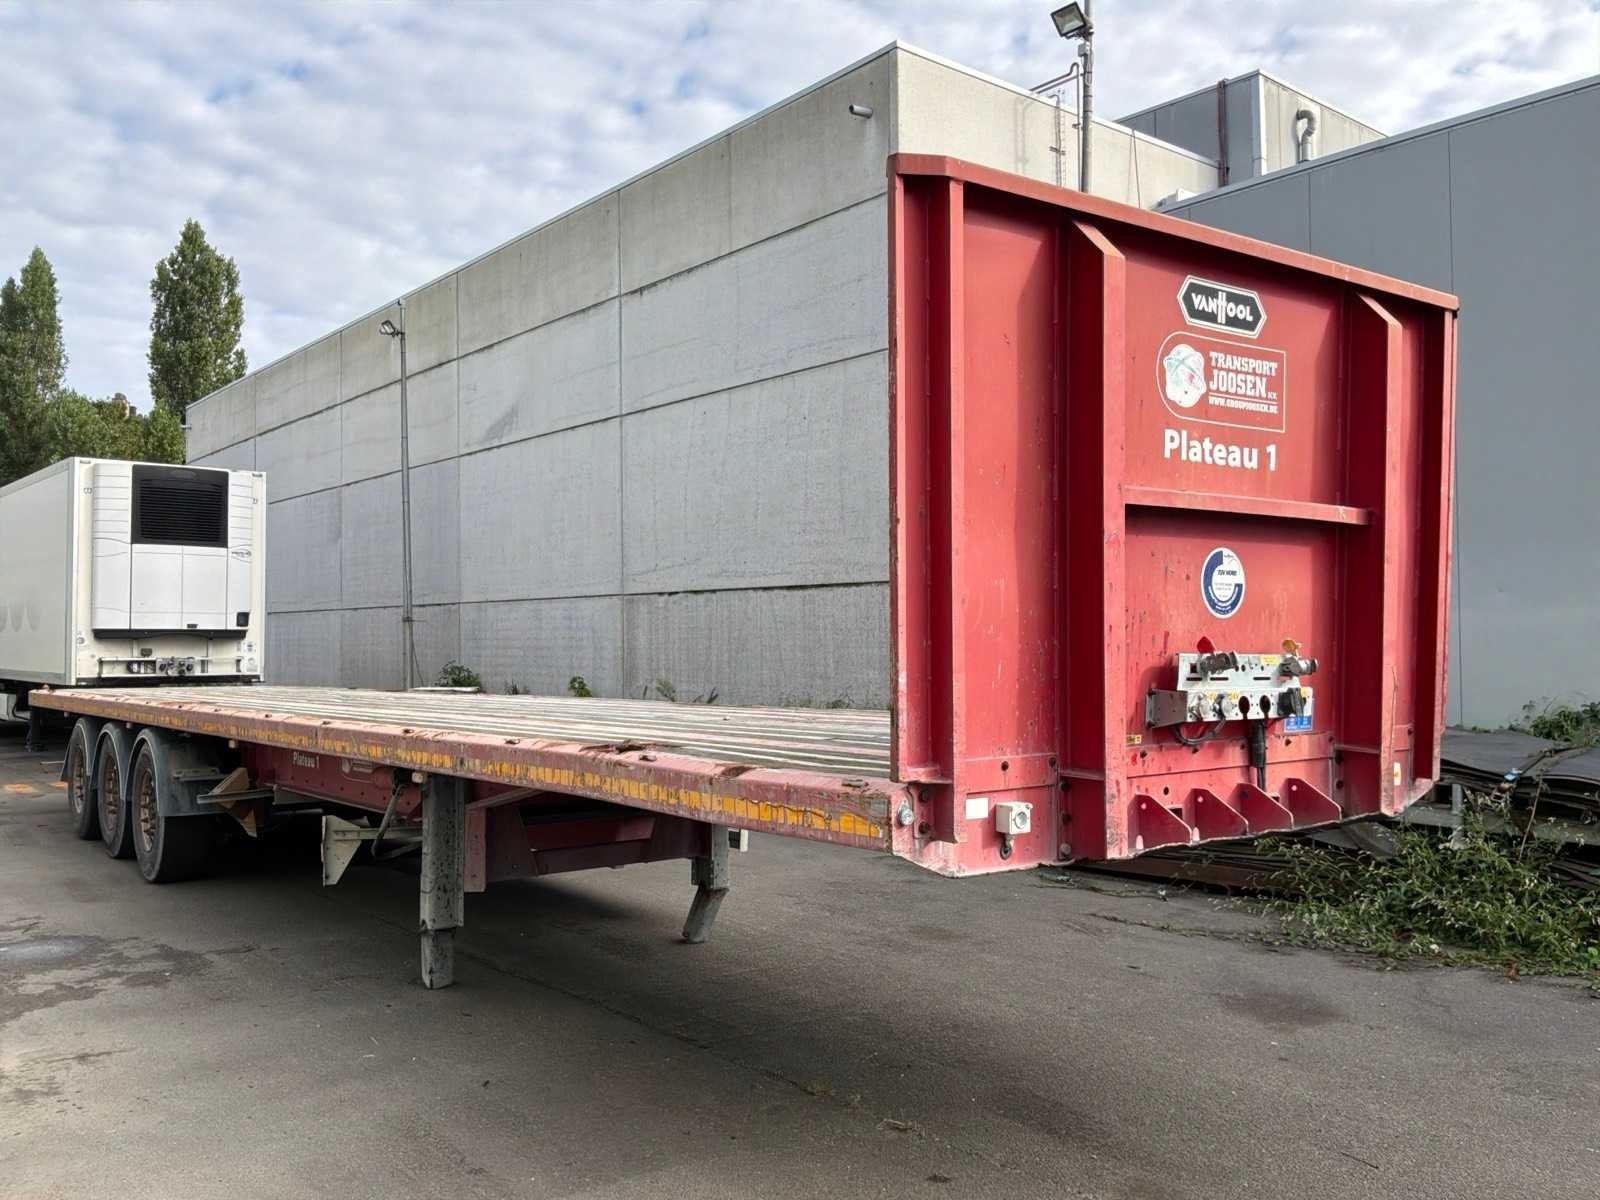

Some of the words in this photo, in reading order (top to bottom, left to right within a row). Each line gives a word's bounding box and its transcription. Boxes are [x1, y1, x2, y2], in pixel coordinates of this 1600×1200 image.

[1209, 351, 1278, 376] TRANSPORT
[1209, 369, 1267, 398] JOOSEN
[1163, 429, 1258, 469] Plateau
[1266, 444, 1277, 471] 1
[293, 751, 315, 768] Plateau
